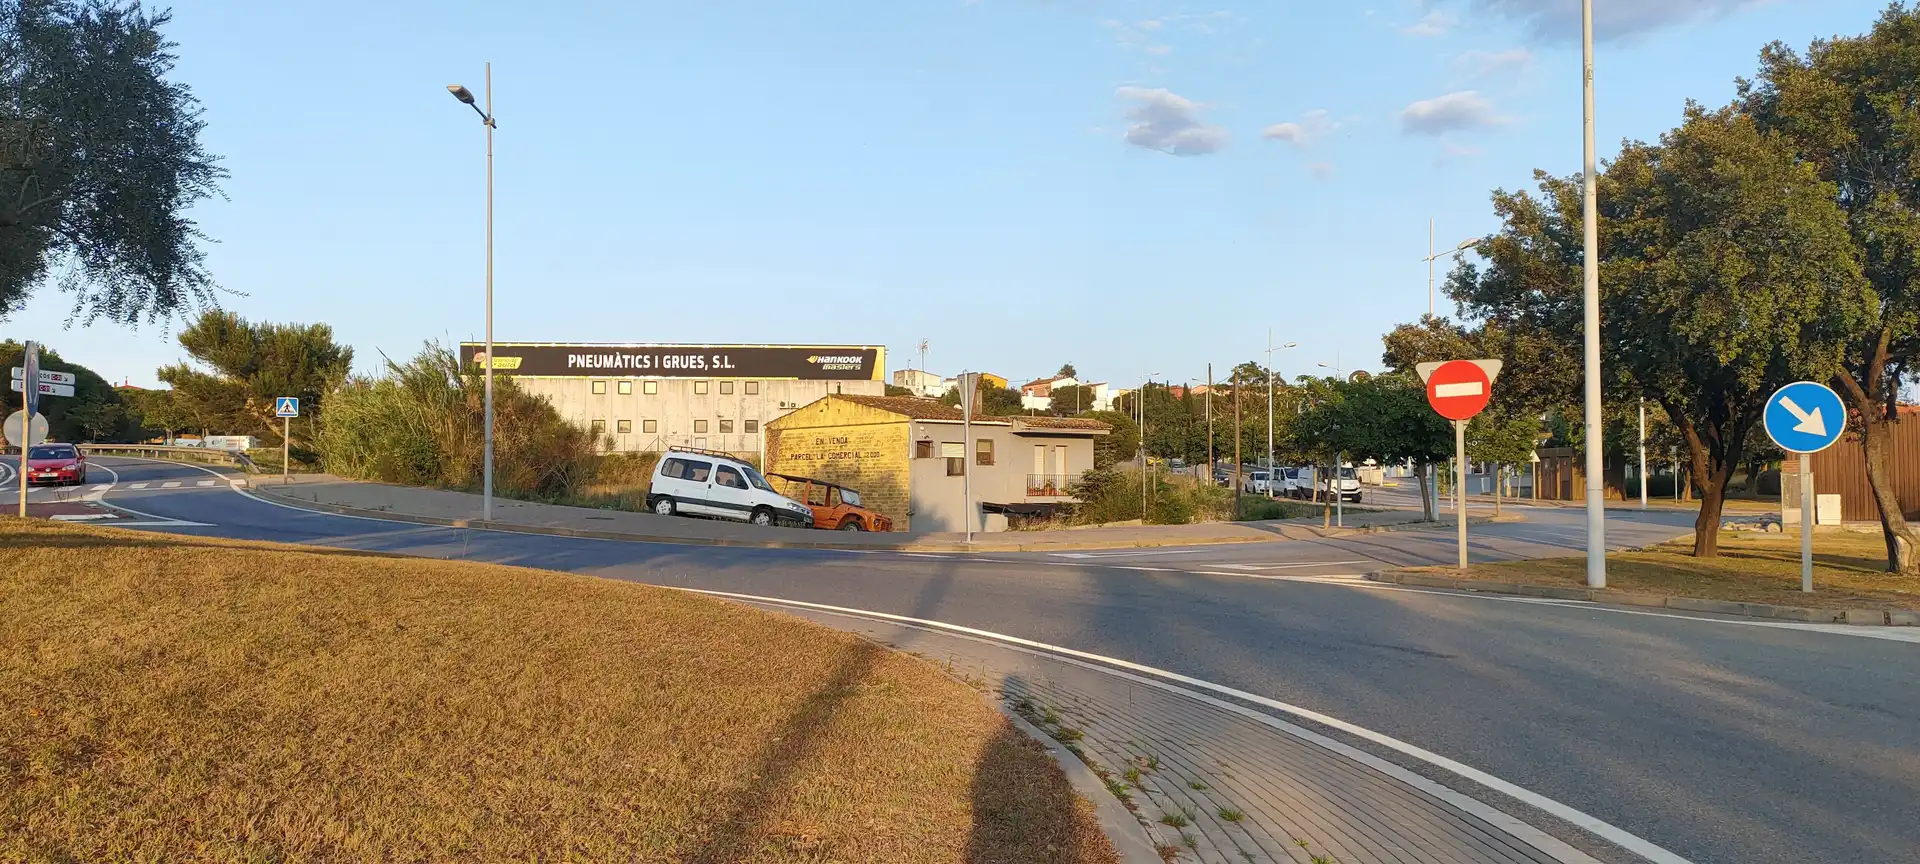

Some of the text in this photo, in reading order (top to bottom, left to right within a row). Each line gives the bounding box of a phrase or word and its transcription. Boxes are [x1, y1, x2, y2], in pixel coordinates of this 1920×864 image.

[568, 352, 735, 370] PNEUMÀTICS I GRUES, S.L.
[828, 451, 862, 459] COMERCIAL
